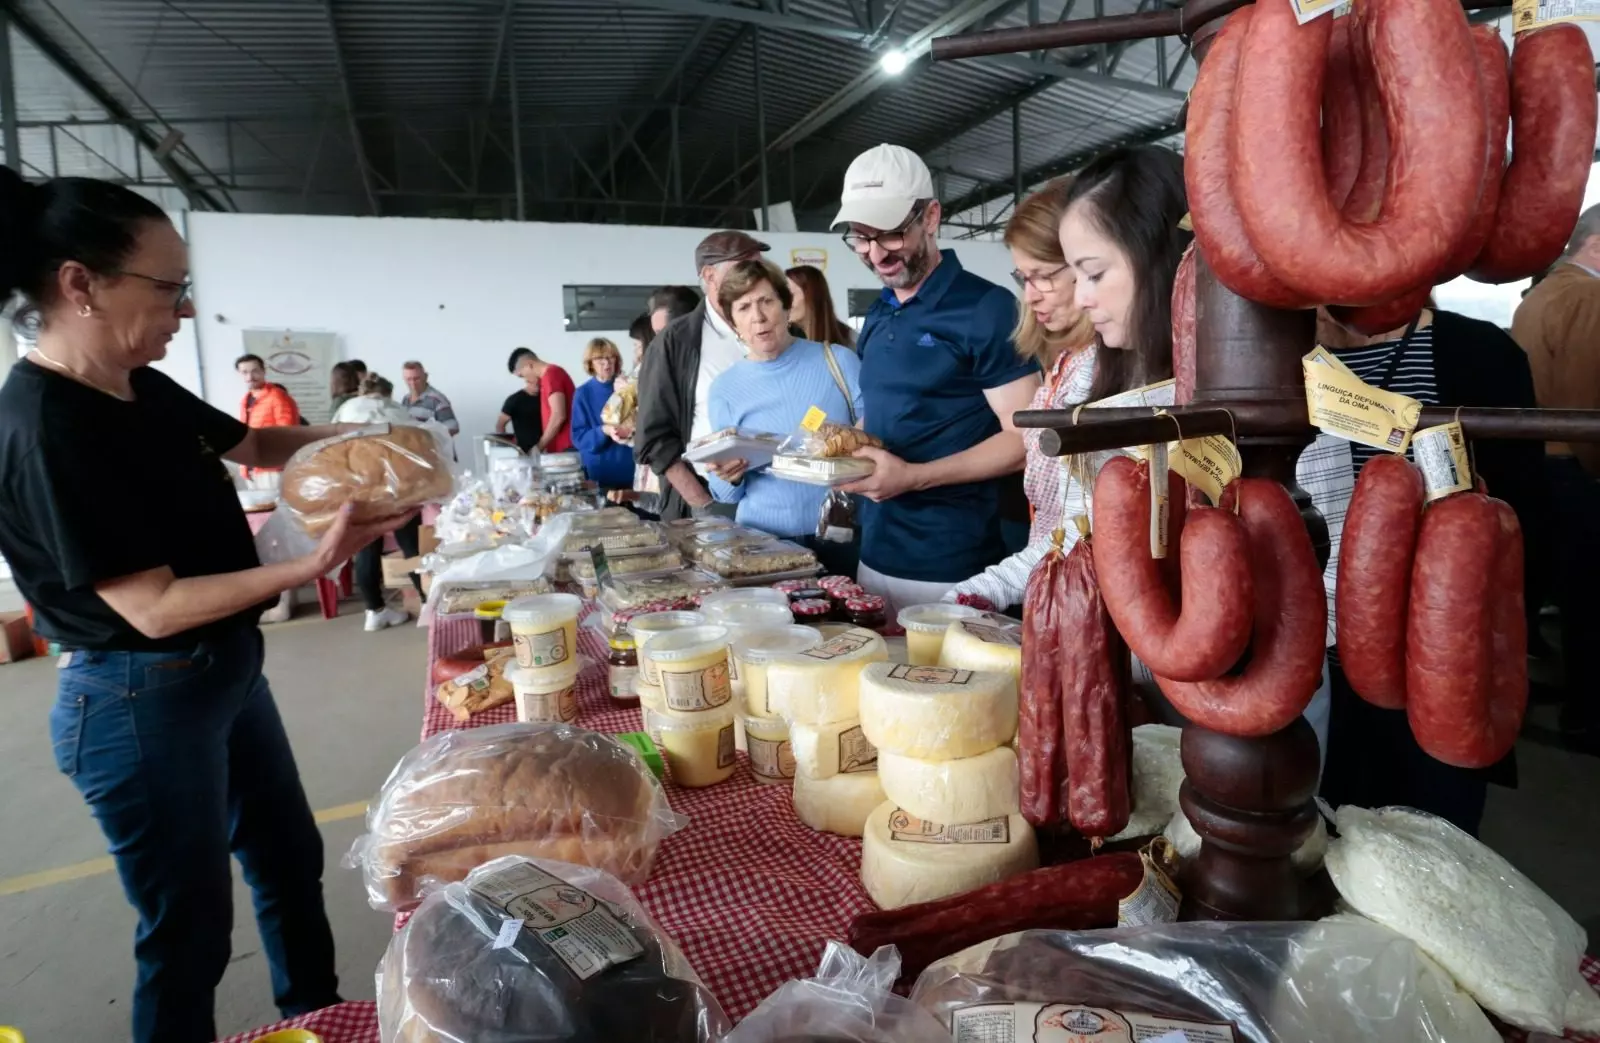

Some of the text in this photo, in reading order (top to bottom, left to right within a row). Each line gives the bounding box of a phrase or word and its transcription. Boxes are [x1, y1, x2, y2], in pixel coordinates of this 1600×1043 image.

[1317, 382, 1353, 397] LINGUIÇA
[1339, 396, 1369, 411] DA OMA
